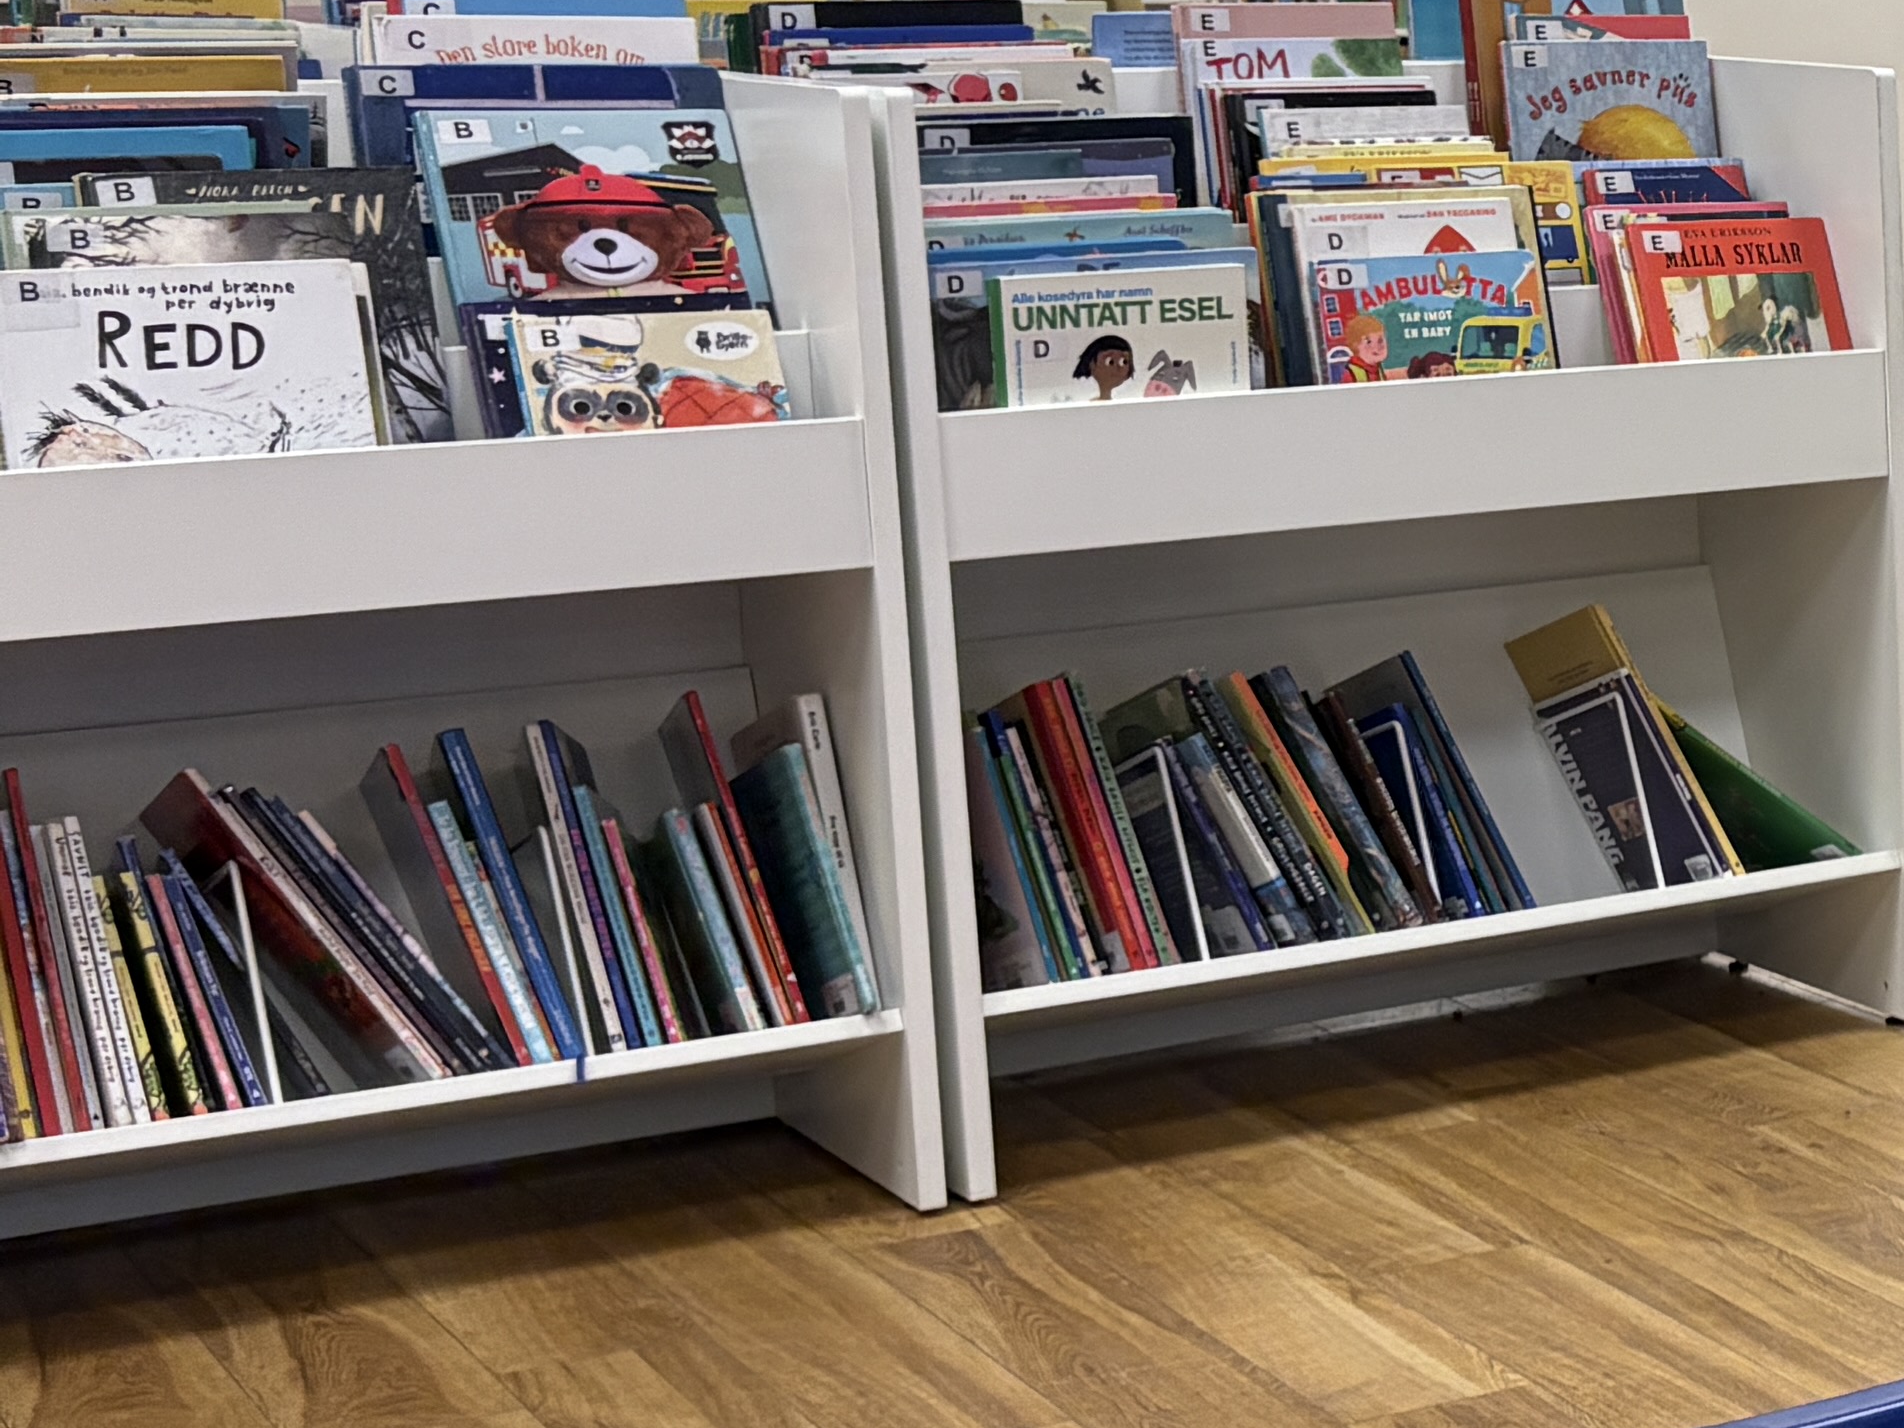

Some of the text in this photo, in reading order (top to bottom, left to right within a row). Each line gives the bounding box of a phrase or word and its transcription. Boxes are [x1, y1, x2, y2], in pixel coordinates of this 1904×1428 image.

[782, 12, 796, 30] D
[1201, 14, 1215, 30] E
[407, 30, 426, 50] C
[1535, 24, 1548, 40] E
[482, 36, 537, 61] store
[544, 34, 607, 61] boken
[1203, 40, 1217, 57] E
[1206, 47, 1291, 80] TOM
[1524, 50, 1537, 68] E
[378, 76, 398, 94] C
[1526, 86, 1567, 121] Jeg
[1569, 69, 1651, 97] savner
[454, 122, 473, 139] B
[1287, 121, 1301, 138] E
[114, 183, 134, 202] B
[1604, 176, 1617, 192] E
[1603, 214, 1616, 230] E
[70, 229, 91, 249] B
[1328, 233, 1343, 250] D
[1652, 235, 1665, 251] E
[1665, 242, 1803, 269] MALLA SYKLAR
[948, 275, 964, 293] D
[1338, 268, 1353, 285] D
[20, 281, 41, 303] B
[137, 285, 156, 300] og
[160, 280, 214, 295] trond
[222, 278, 296, 295] brænne
[1012, 287, 1153, 305] Alle kosedyra har namn
[165, 294, 277, 315] per dybvig
[1012, 296, 1234, 332] UNNTATT ESEL
[1399, 310, 1453, 323] TAR IMOT
[98, 310, 266, 371] REDD
[541, 329, 561, 348] B
[1404, 326, 1452, 339] EN BABY
[1033, 340, 1050, 358] D
